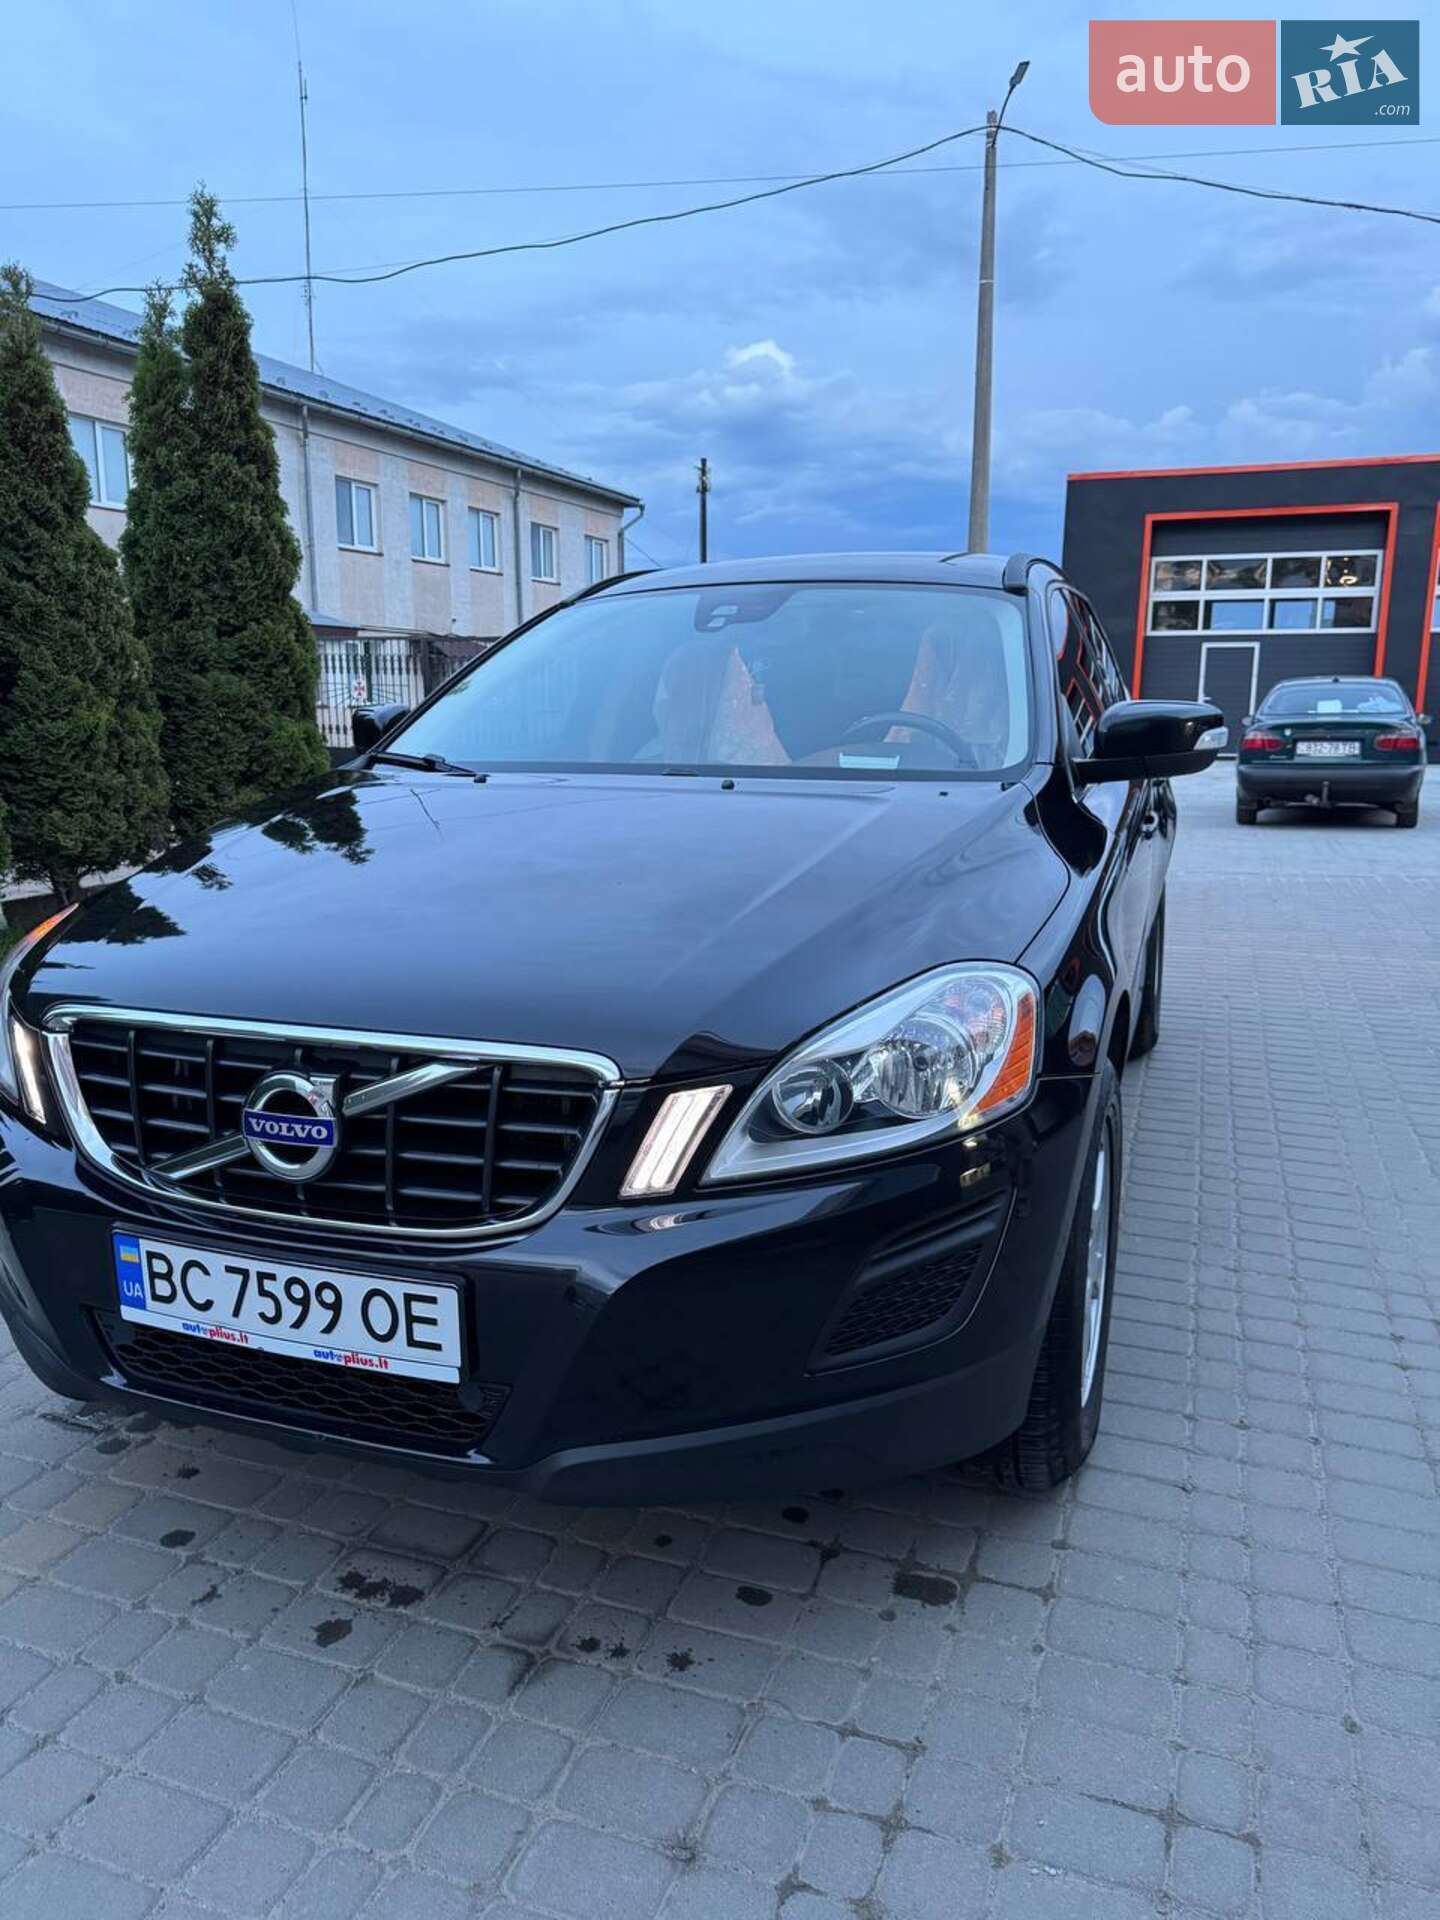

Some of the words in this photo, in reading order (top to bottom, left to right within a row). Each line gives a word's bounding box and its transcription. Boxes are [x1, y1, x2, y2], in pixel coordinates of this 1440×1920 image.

[248, 1117, 328, 1139] VOLVO
[122, 1279, 143, 1298] UA
[145, 1249, 214, 1312] BC
[224, 1265, 342, 1334] 7599
[360, 1287, 443, 1351] OE
